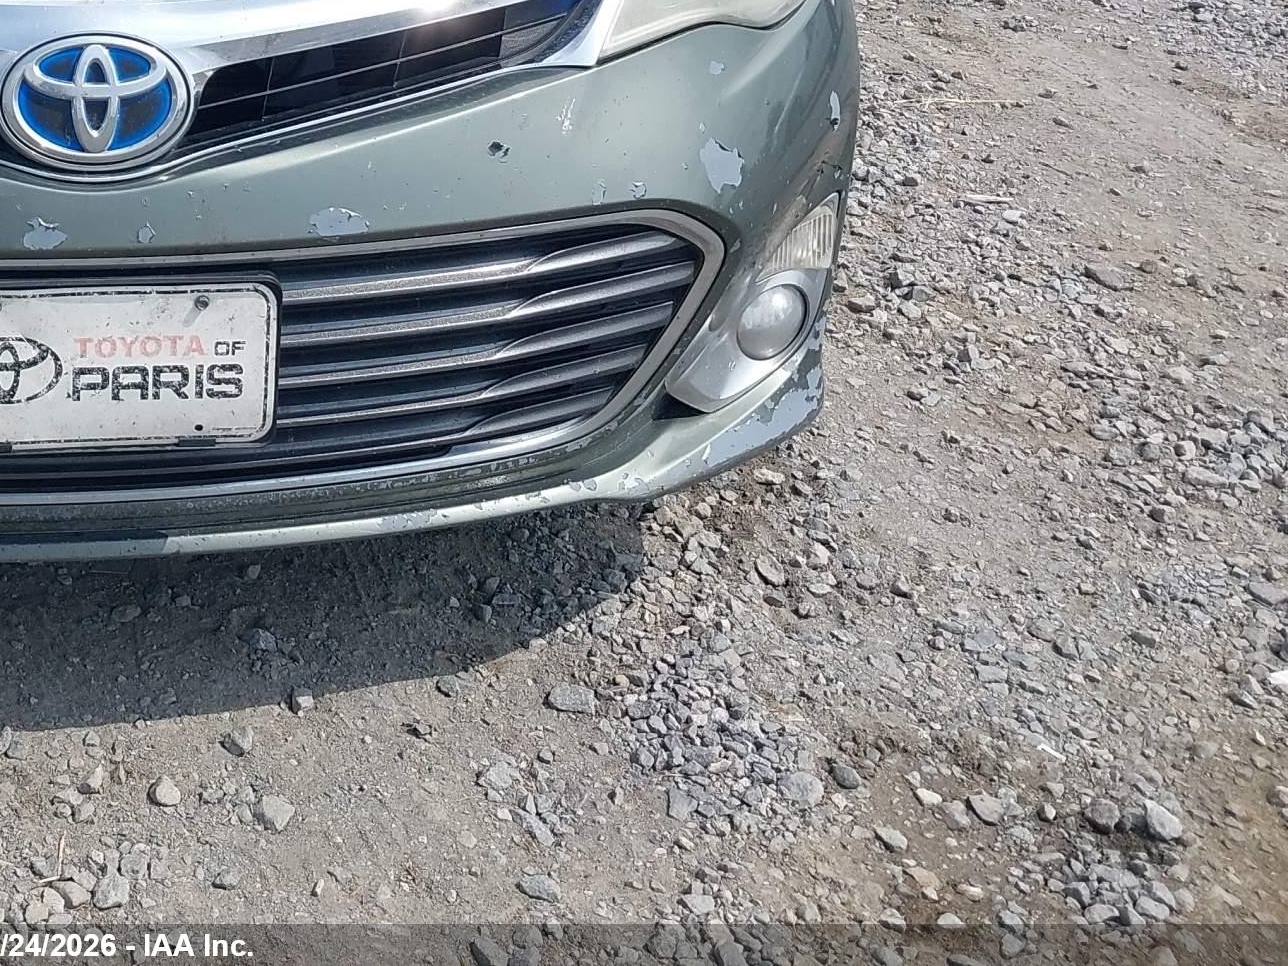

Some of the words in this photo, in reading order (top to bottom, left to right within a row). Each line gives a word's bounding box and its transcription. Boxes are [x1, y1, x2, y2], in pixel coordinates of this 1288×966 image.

[73, 334, 205, 359] TOYOTA
[214, 340, 247, 356] OF
[71, 363, 245, 401] PARIS
